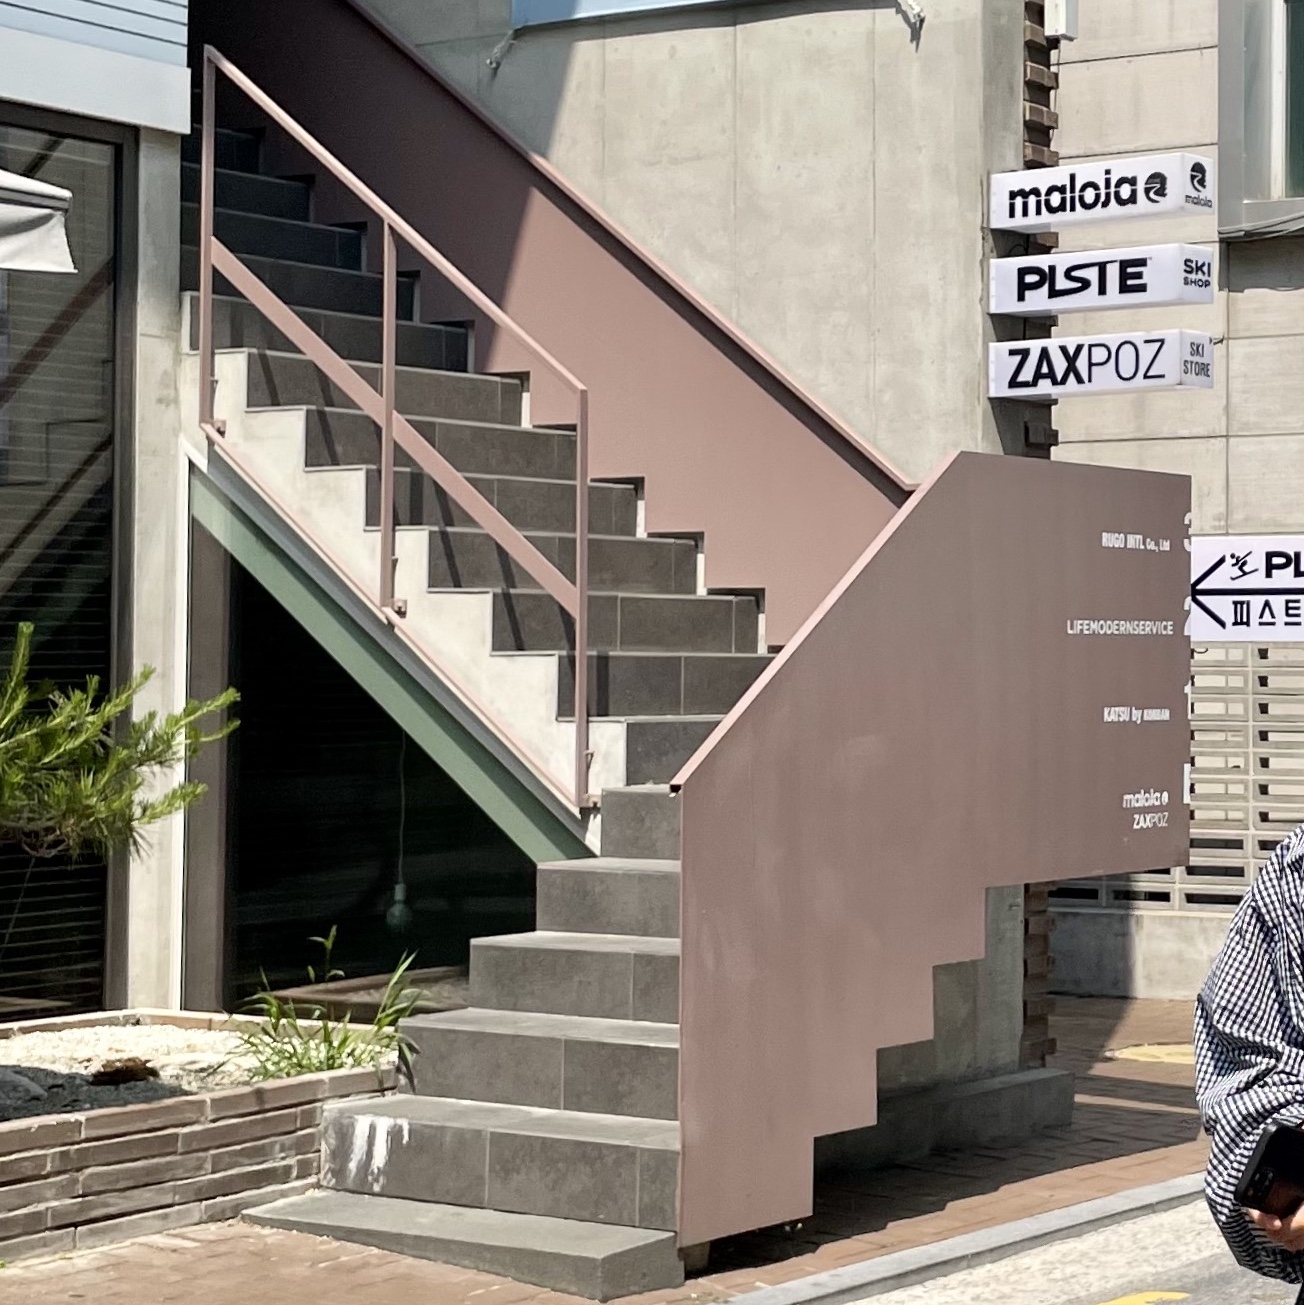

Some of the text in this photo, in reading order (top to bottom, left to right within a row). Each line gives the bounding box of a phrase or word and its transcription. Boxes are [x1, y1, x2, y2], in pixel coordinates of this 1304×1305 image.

[1008, 168, 1138, 219] maloja
[1183, 258, 1211, 276] SKI
[1183, 276, 1211, 289] SHOP
[1190, 342, 1205, 357] SKI
[1008, 338, 1166, 389] ZAXPOZ
[1183, 359, 1211, 378] STORE
[1067, 619, 1174, 635] LIFEMODERNSERVICE
[1103, 706, 1131, 722] KATSU
[1131, 706, 1142, 724] by
[1133, 812, 1168, 829] ZAXPOZ
